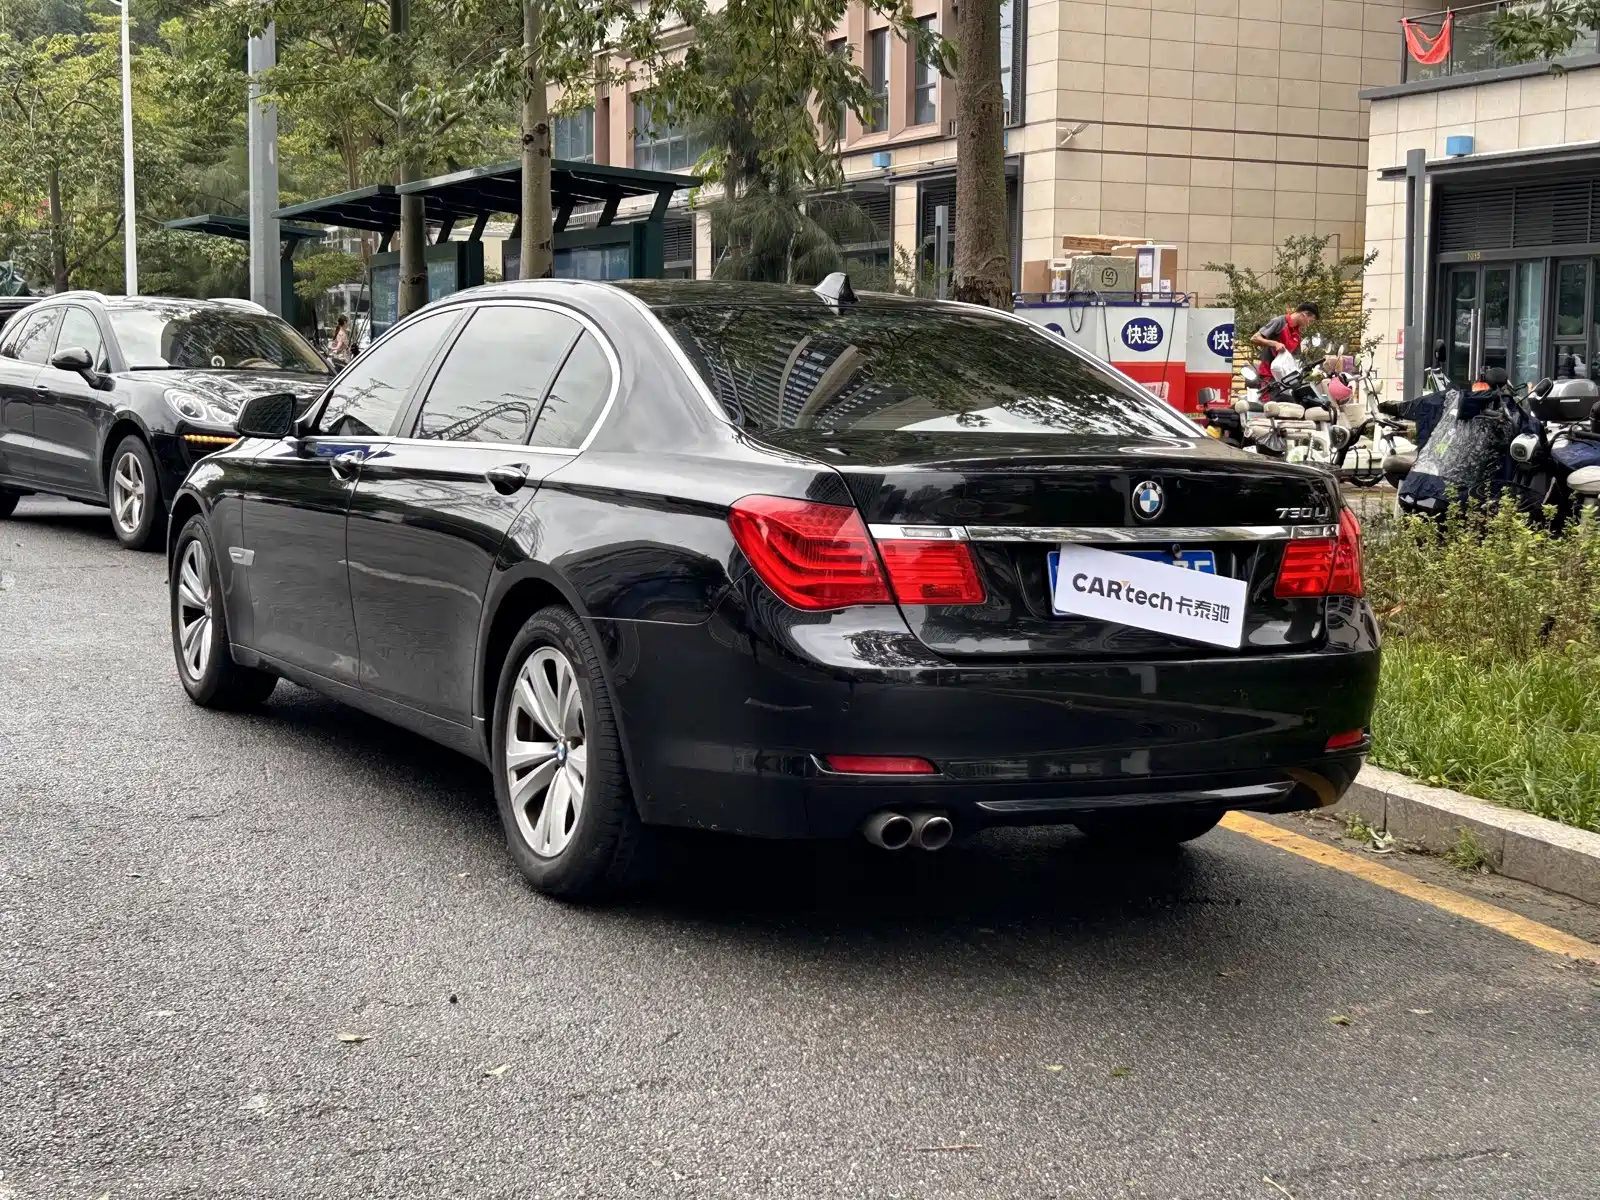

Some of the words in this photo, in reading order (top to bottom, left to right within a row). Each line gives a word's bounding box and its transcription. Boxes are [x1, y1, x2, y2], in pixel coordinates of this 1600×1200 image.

[1127, 324, 1158, 344] 快递
[1212, 330, 1234, 350] 快
[1072, 572, 1173, 612] CARtech
[1175, 595, 1230, 624] 卡泰驰
